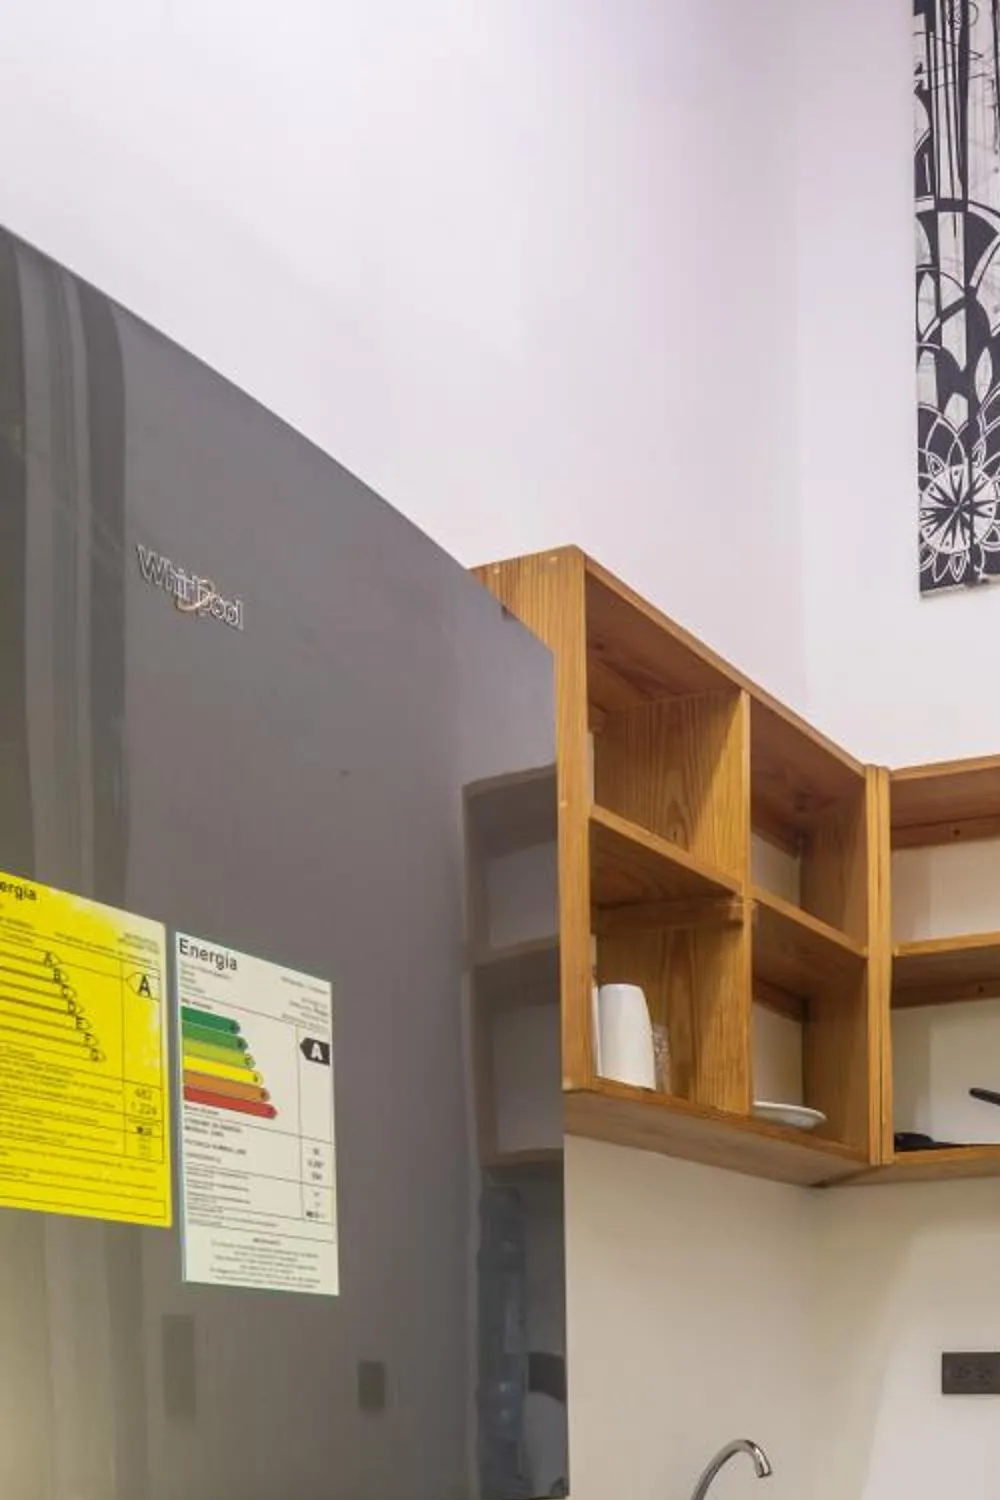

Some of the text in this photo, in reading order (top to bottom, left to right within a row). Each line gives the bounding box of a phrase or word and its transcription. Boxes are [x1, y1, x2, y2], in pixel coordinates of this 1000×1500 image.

[179, 937, 237, 971] Energia
[138, 974, 151, 997] A
[311, 1042, 323, 1060] A
